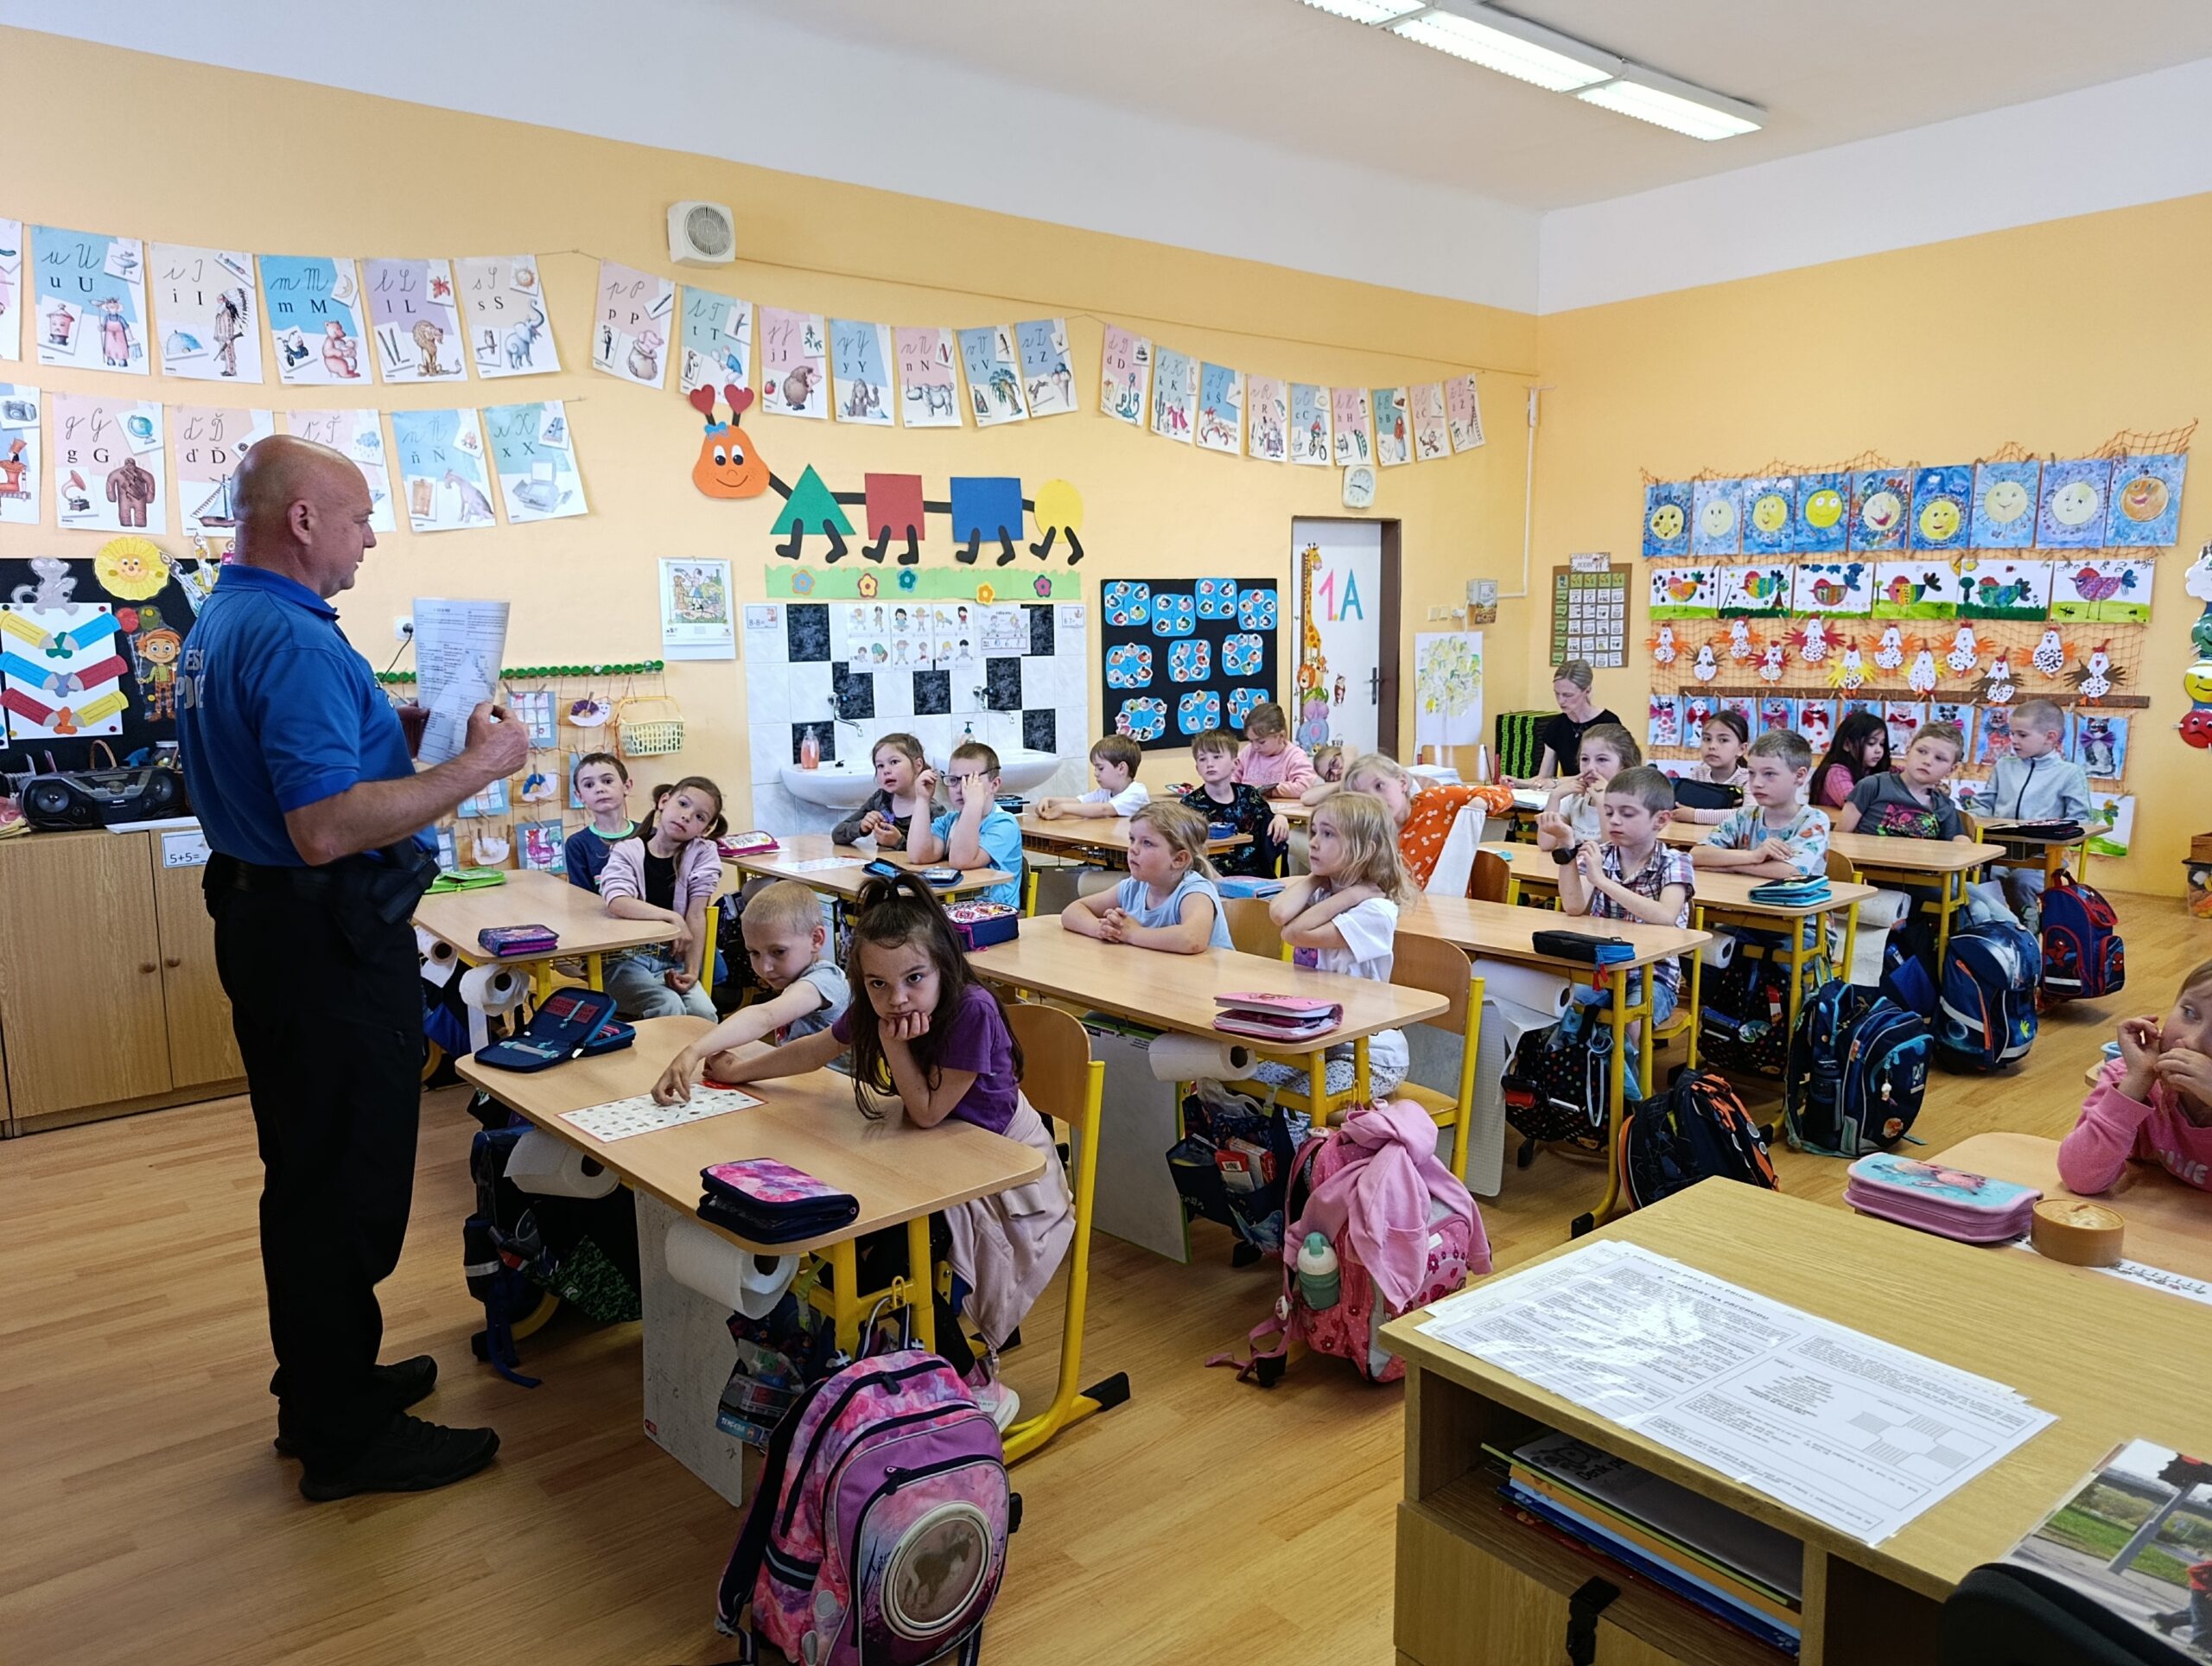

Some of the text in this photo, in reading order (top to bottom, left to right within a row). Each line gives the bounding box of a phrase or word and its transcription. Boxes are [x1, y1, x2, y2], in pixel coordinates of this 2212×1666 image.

[41, 244, 100, 269] u U
[163, 258, 203, 282] i I
[472, 266, 497, 290] s S
[50, 277, 93, 292] u U
[270, 268, 328, 291] m M
[374, 269, 416, 291] l L
[173, 288, 202, 305] i I
[607, 281, 645, 300] p P
[278, 300, 327, 314] m M
[387, 300, 416, 314] l L
[478, 296, 503, 310] s S
[688, 298, 723, 321] t T
[608, 308, 639, 324] p P
[693, 326, 720, 340] t T
[768, 319, 794, 346] j J
[837, 330, 870, 357] y Y
[900, 336, 931, 355] n N
[966, 335, 988, 356] v V
[1108, 334, 1128, 354] d D
[771, 348, 787, 362] j J
[1039, 352, 1048, 362] Z
[1107, 355, 1125, 369] d D
[843, 361, 867, 373] y Y
[921, 360, 930, 372] N
[982, 359, 989, 370] V
[1157, 355, 1184, 377] k K
[1159, 376, 1177, 391] k K
[1262, 404, 1268, 414] R
[1303, 410, 1308, 420] C
[66, 408, 111, 442] g G
[493, 413, 535, 438] x X
[1346, 413, 1353, 422] H
[1386, 414, 1390, 423] B
[184, 413, 224, 442] ď Ď
[402, 416, 448, 443] ň Ň
[67, 448, 109, 463] g G
[186, 447, 226, 464] ď Ď
[411, 447, 446, 464] ň Ň
[503, 442, 535, 458] x X
[1171, 609, 1176, 620] 2
